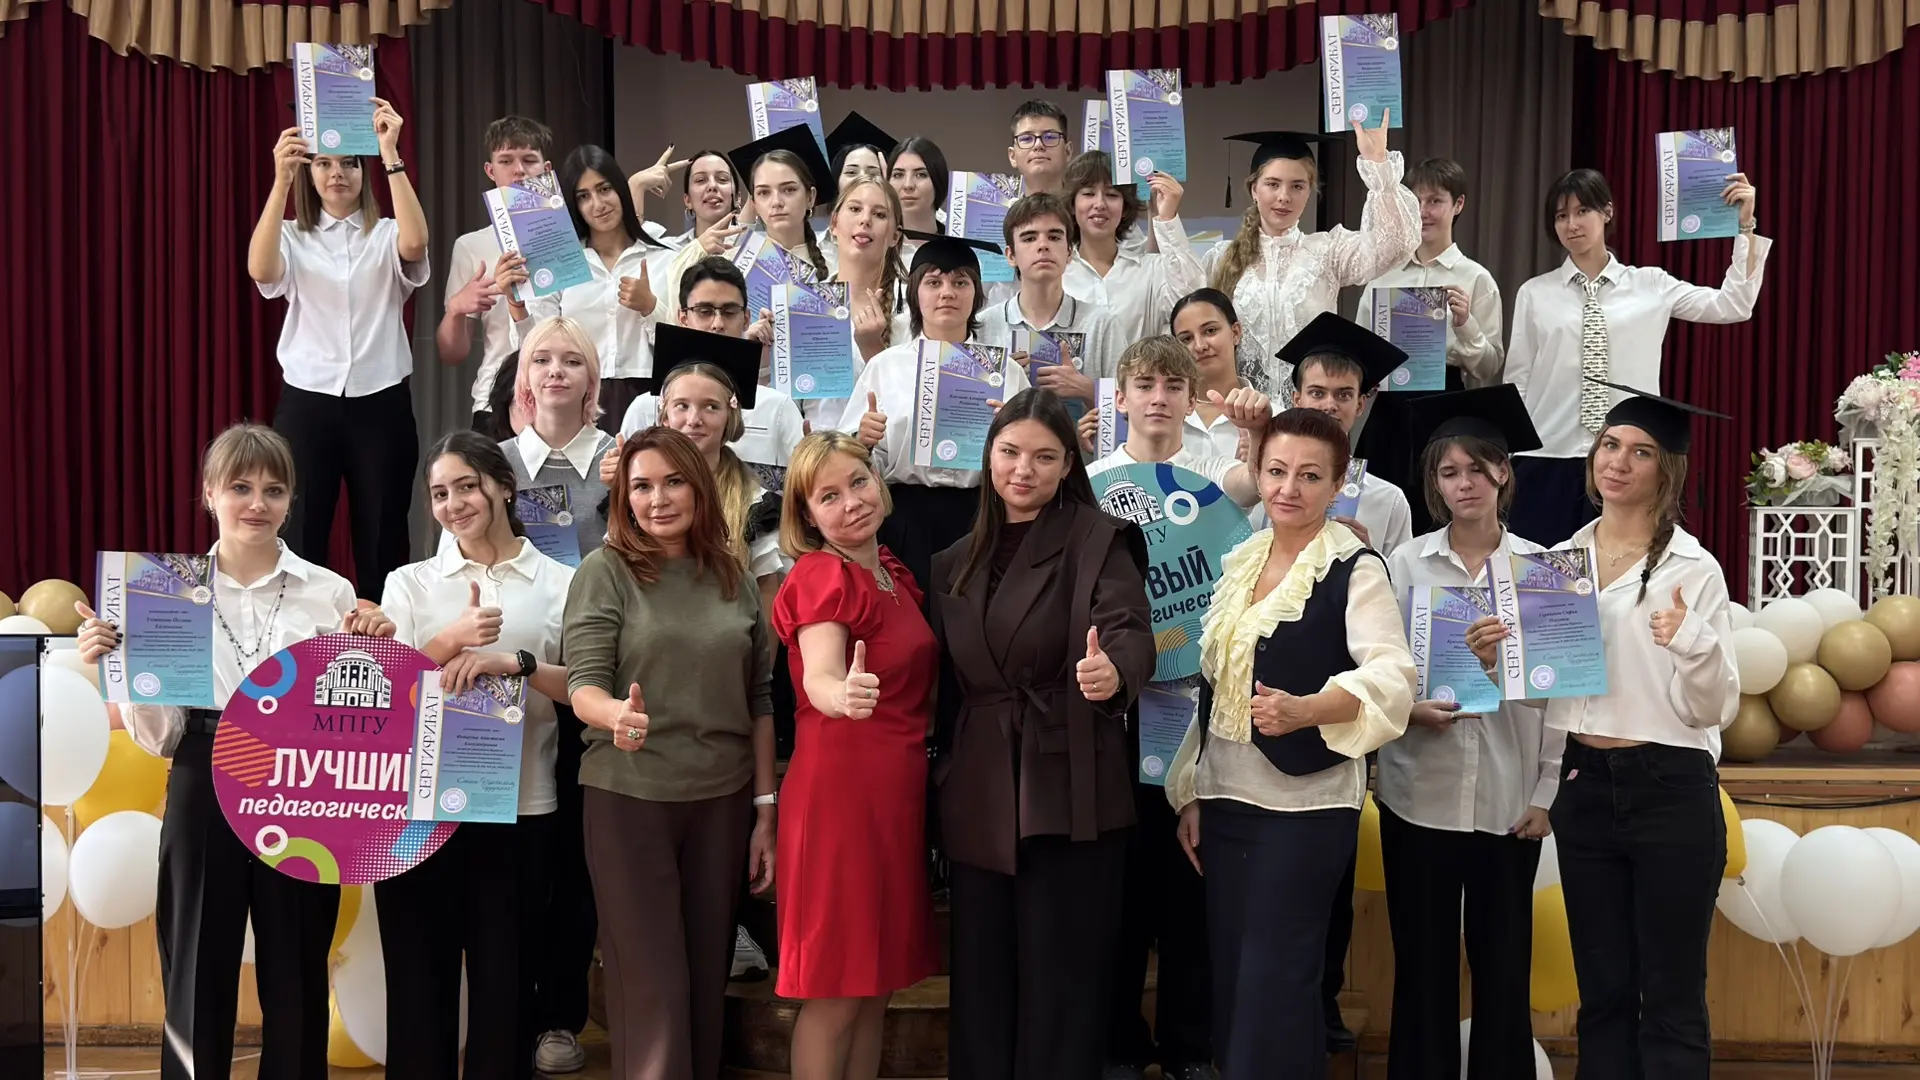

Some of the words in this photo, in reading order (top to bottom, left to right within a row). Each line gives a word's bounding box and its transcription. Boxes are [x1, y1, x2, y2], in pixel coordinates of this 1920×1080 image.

[300, 59, 315, 138] СЕРТИФИКАТ
[1328, 33, 1342, 115] СЕРТИФИКАТ
[1113, 86, 1128, 168] СЕРТИФИКАТ
[775, 301, 789, 384] СЕРТИФИКАТ
[919, 358, 936, 448] СЕРТИФИКАТ
[1147, 544, 1214, 600] ВЫЙ
[312, 713, 389, 735] МПГУ
[419, 692, 439, 799] СЕРТИФИКАТ
[238, 793, 408, 820] педагогическ
